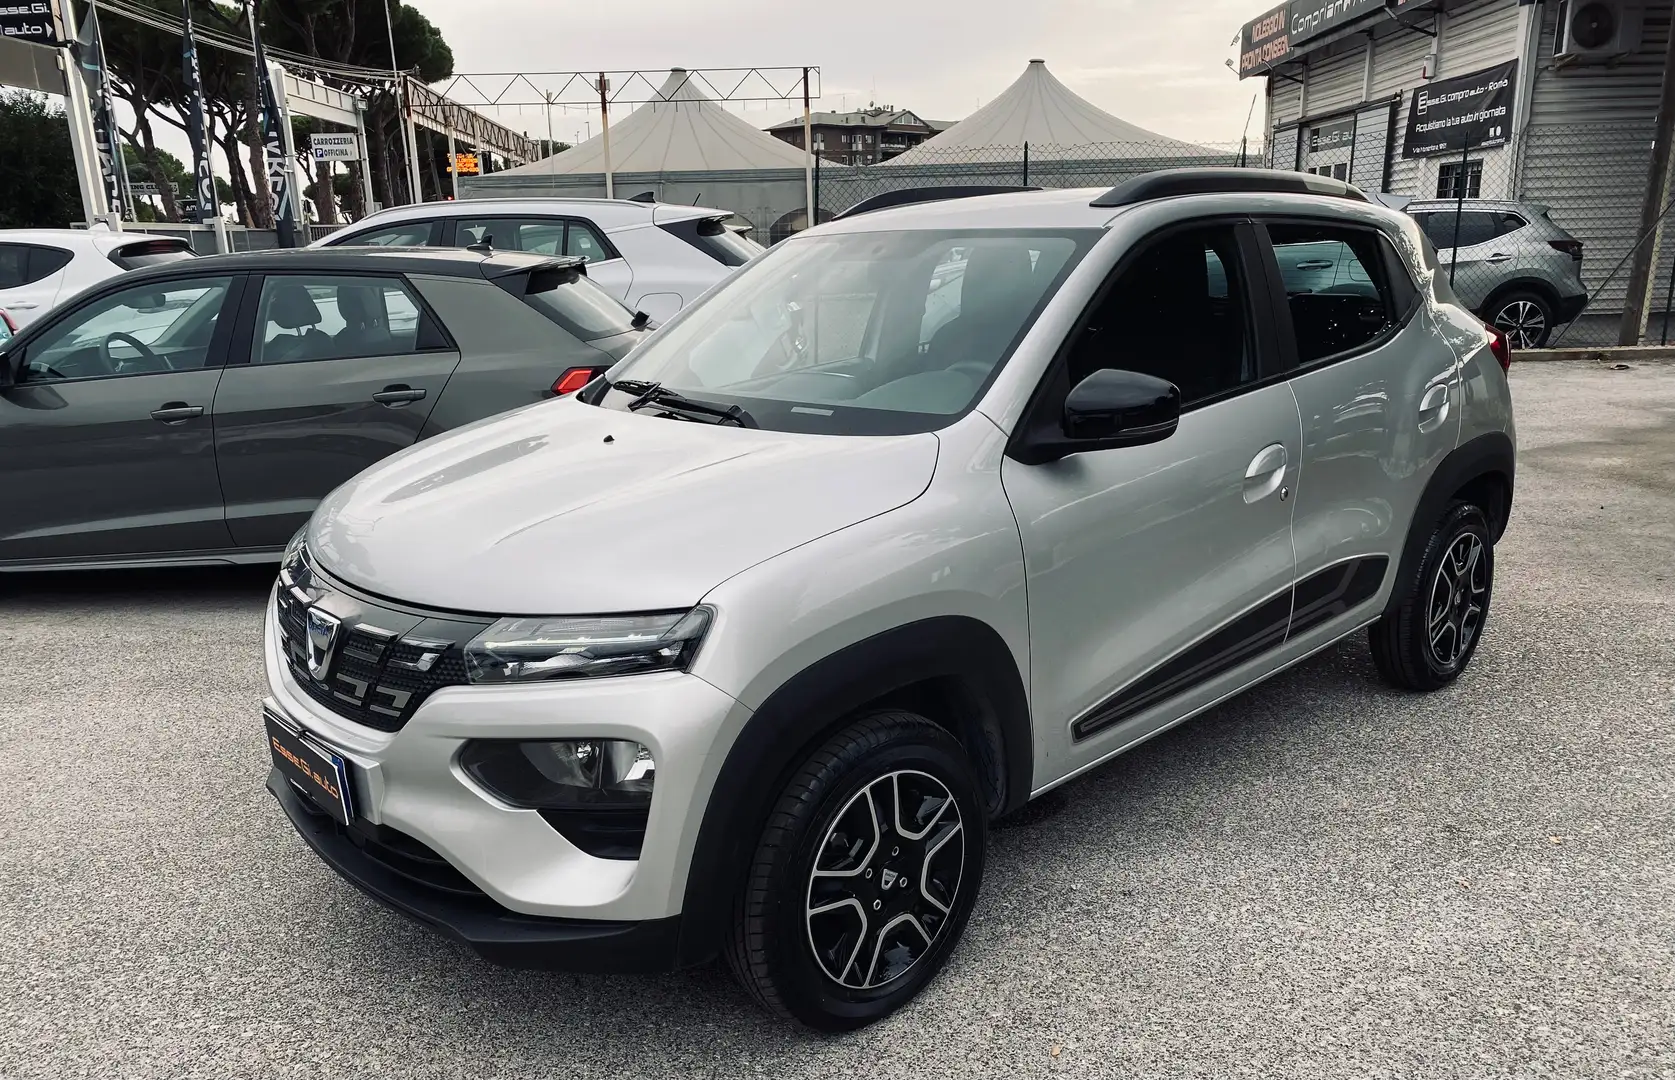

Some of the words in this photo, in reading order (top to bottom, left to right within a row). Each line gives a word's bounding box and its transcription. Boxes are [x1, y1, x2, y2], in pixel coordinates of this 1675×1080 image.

[4, 22, 42, 35] auto
[1447, 90, 1470, 102] compro
[1469, 86, 1484, 96] auto
[1488, 79, 1508, 91] Roma
[1415, 119, 1446, 133] Acquistiamo
[1460, 114, 1473, 124] auto
[1479, 106, 1506, 122] giornata
[324, 149, 349, 157] OFFICINA
